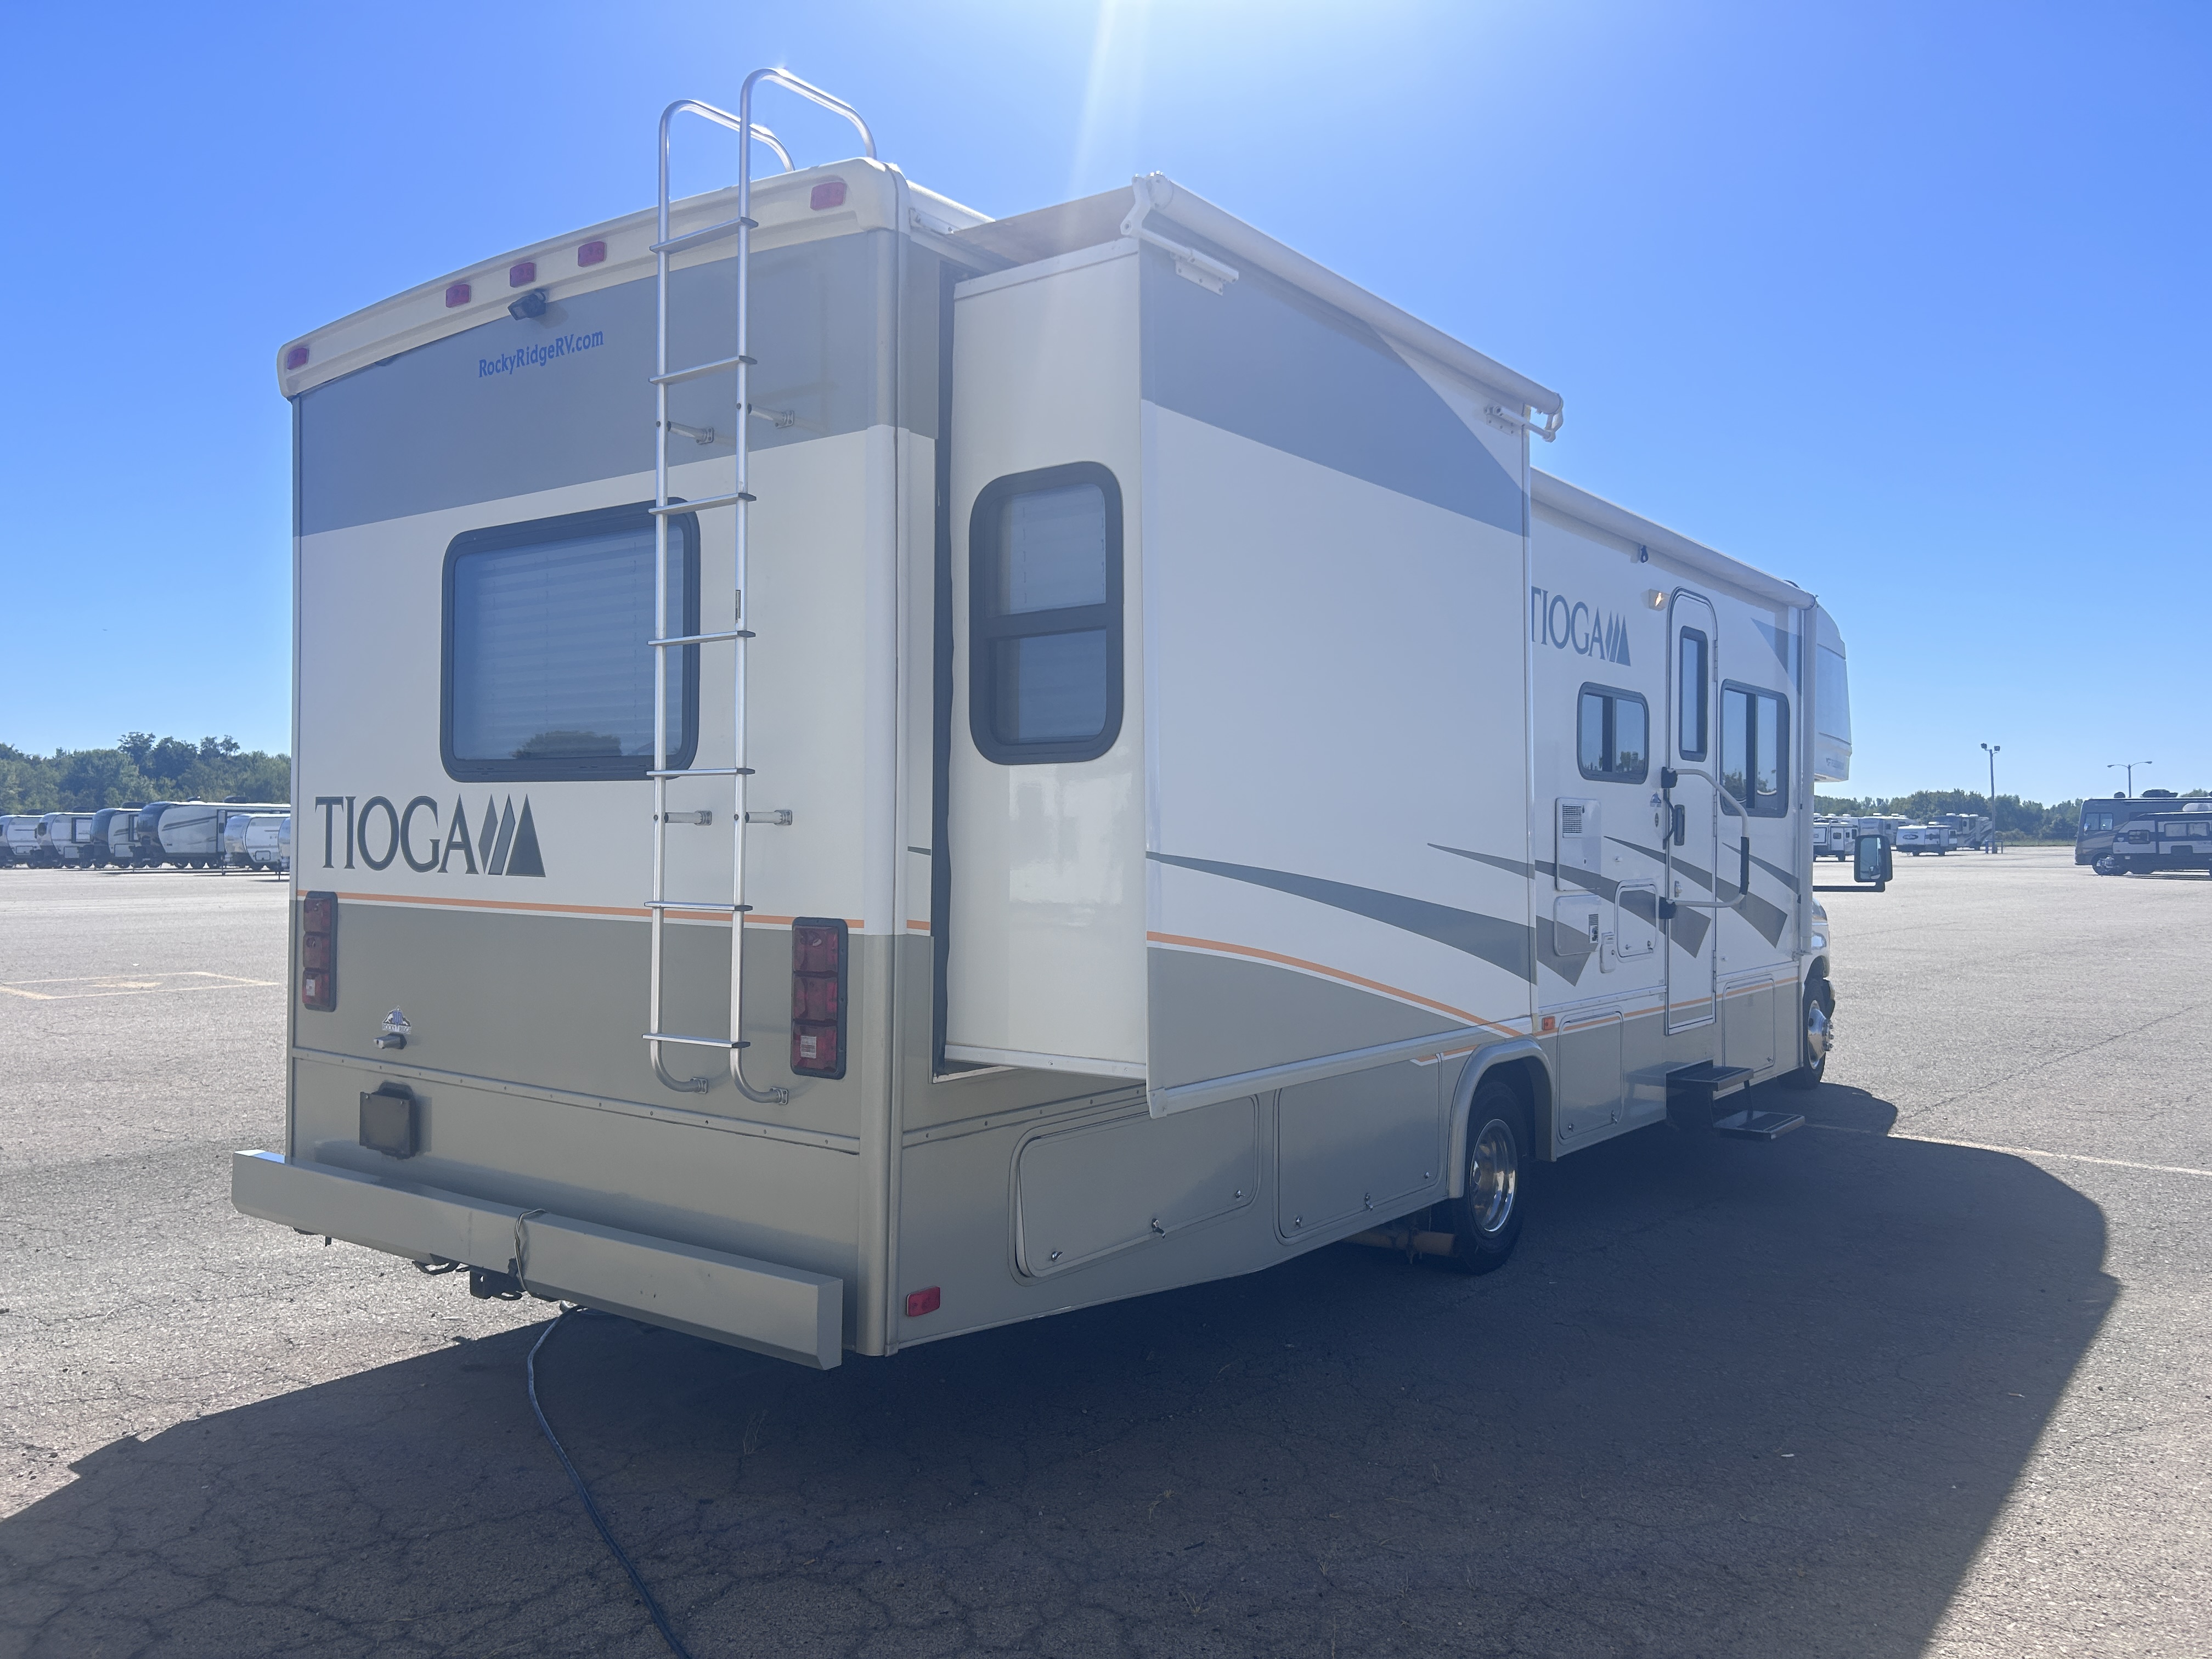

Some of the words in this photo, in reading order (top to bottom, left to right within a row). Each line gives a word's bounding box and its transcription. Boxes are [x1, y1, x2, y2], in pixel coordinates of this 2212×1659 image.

[478, 330, 604, 377] RockyRidgeRV.com
[314, 793, 480, 875] TIOGA
[382, 1023, 395, 1031] ROCKY
